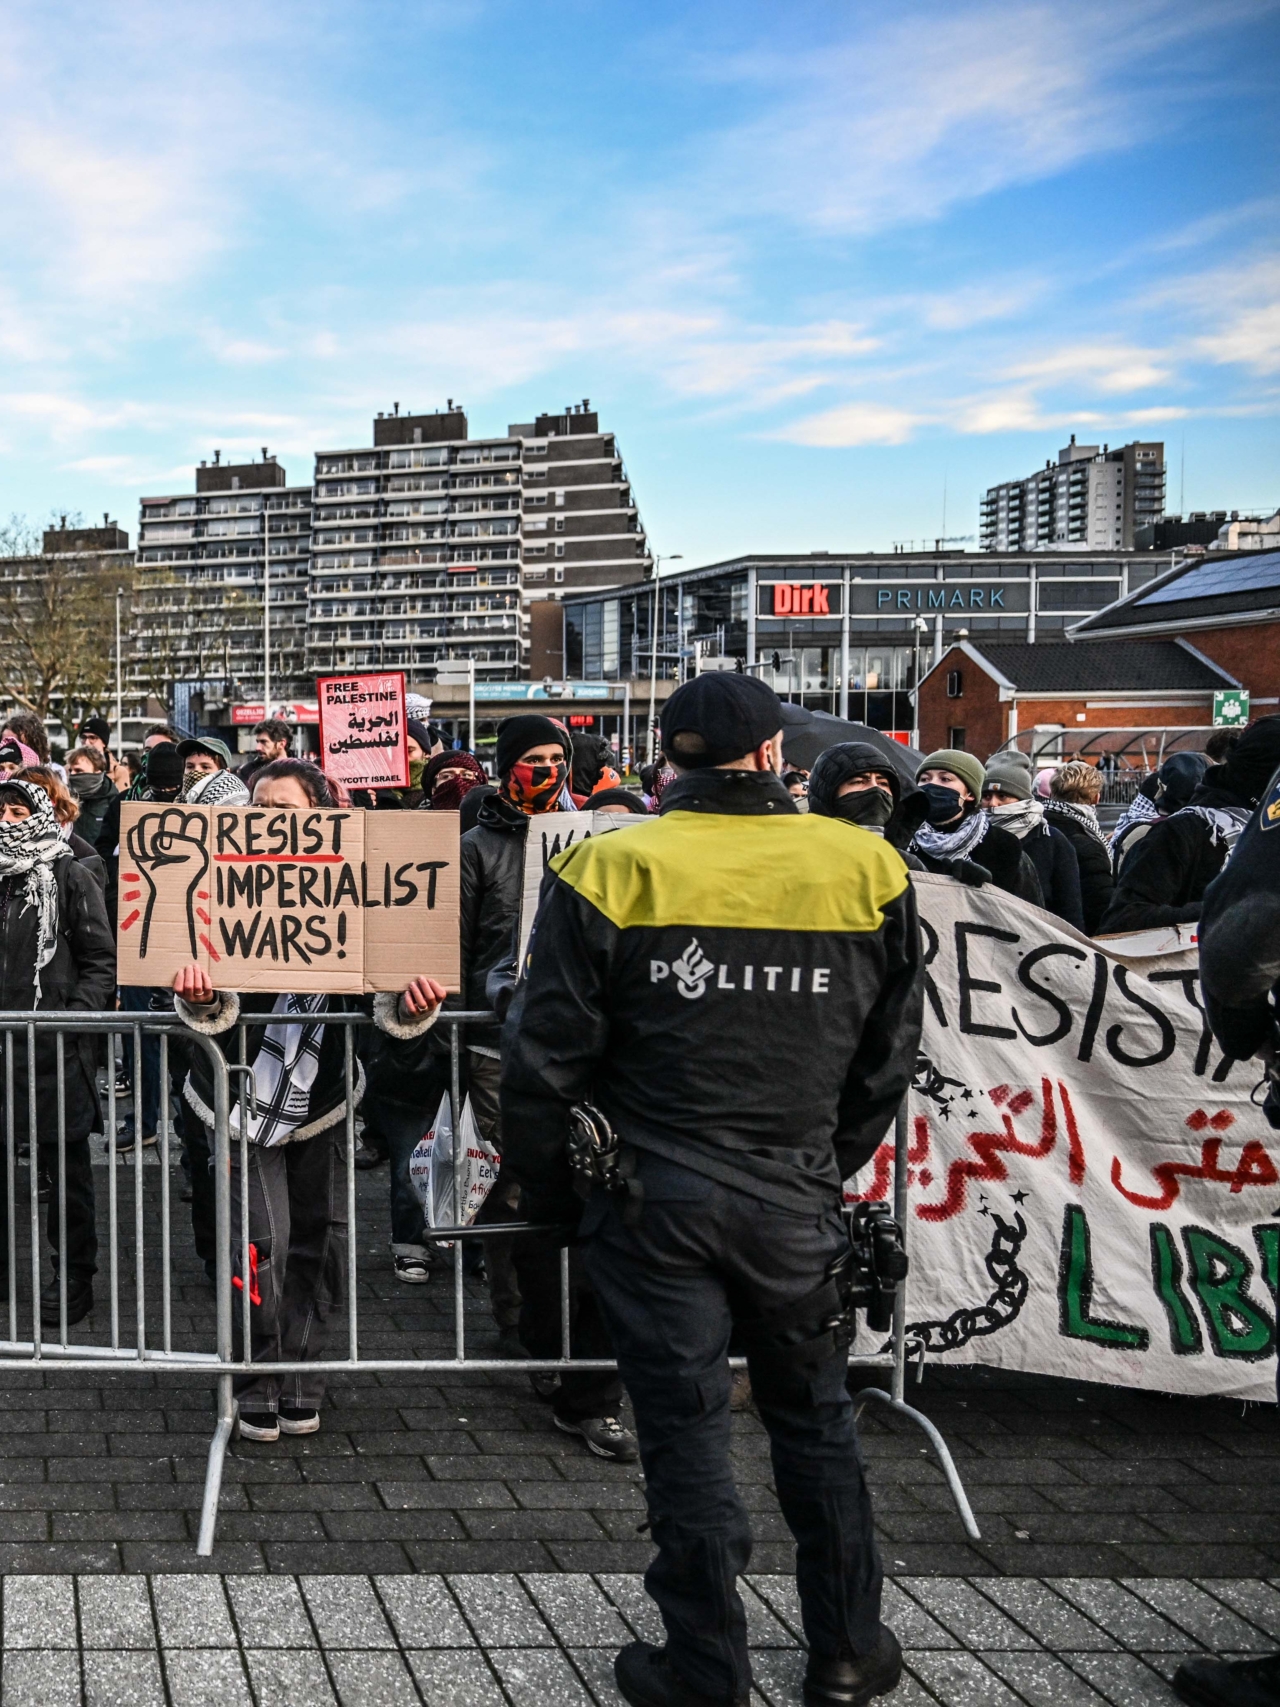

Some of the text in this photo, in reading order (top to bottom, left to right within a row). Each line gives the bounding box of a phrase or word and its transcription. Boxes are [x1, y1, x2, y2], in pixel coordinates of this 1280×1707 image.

[773, 584, 829, 616] Dirk
[877, 588, 1006, 609] PRIMARK
[326, 682, 359, 693] FREE
[326, 691, 398, 705] PALESTINE
[348, 710, 399, 733] الحرية
[328, 731, 400, 754] لفلسطين
[339, 775, 402, 784] YCOTT ISRAEL
[217, 812, 351, 855] RESIST
[216, 861, 450, 910] IMPERIALIST
[219, 910, 347, 966] WARS!
[920, 915, 1235, 1082] RESIST
[1056, 1203, 1280, 1364] LIB
